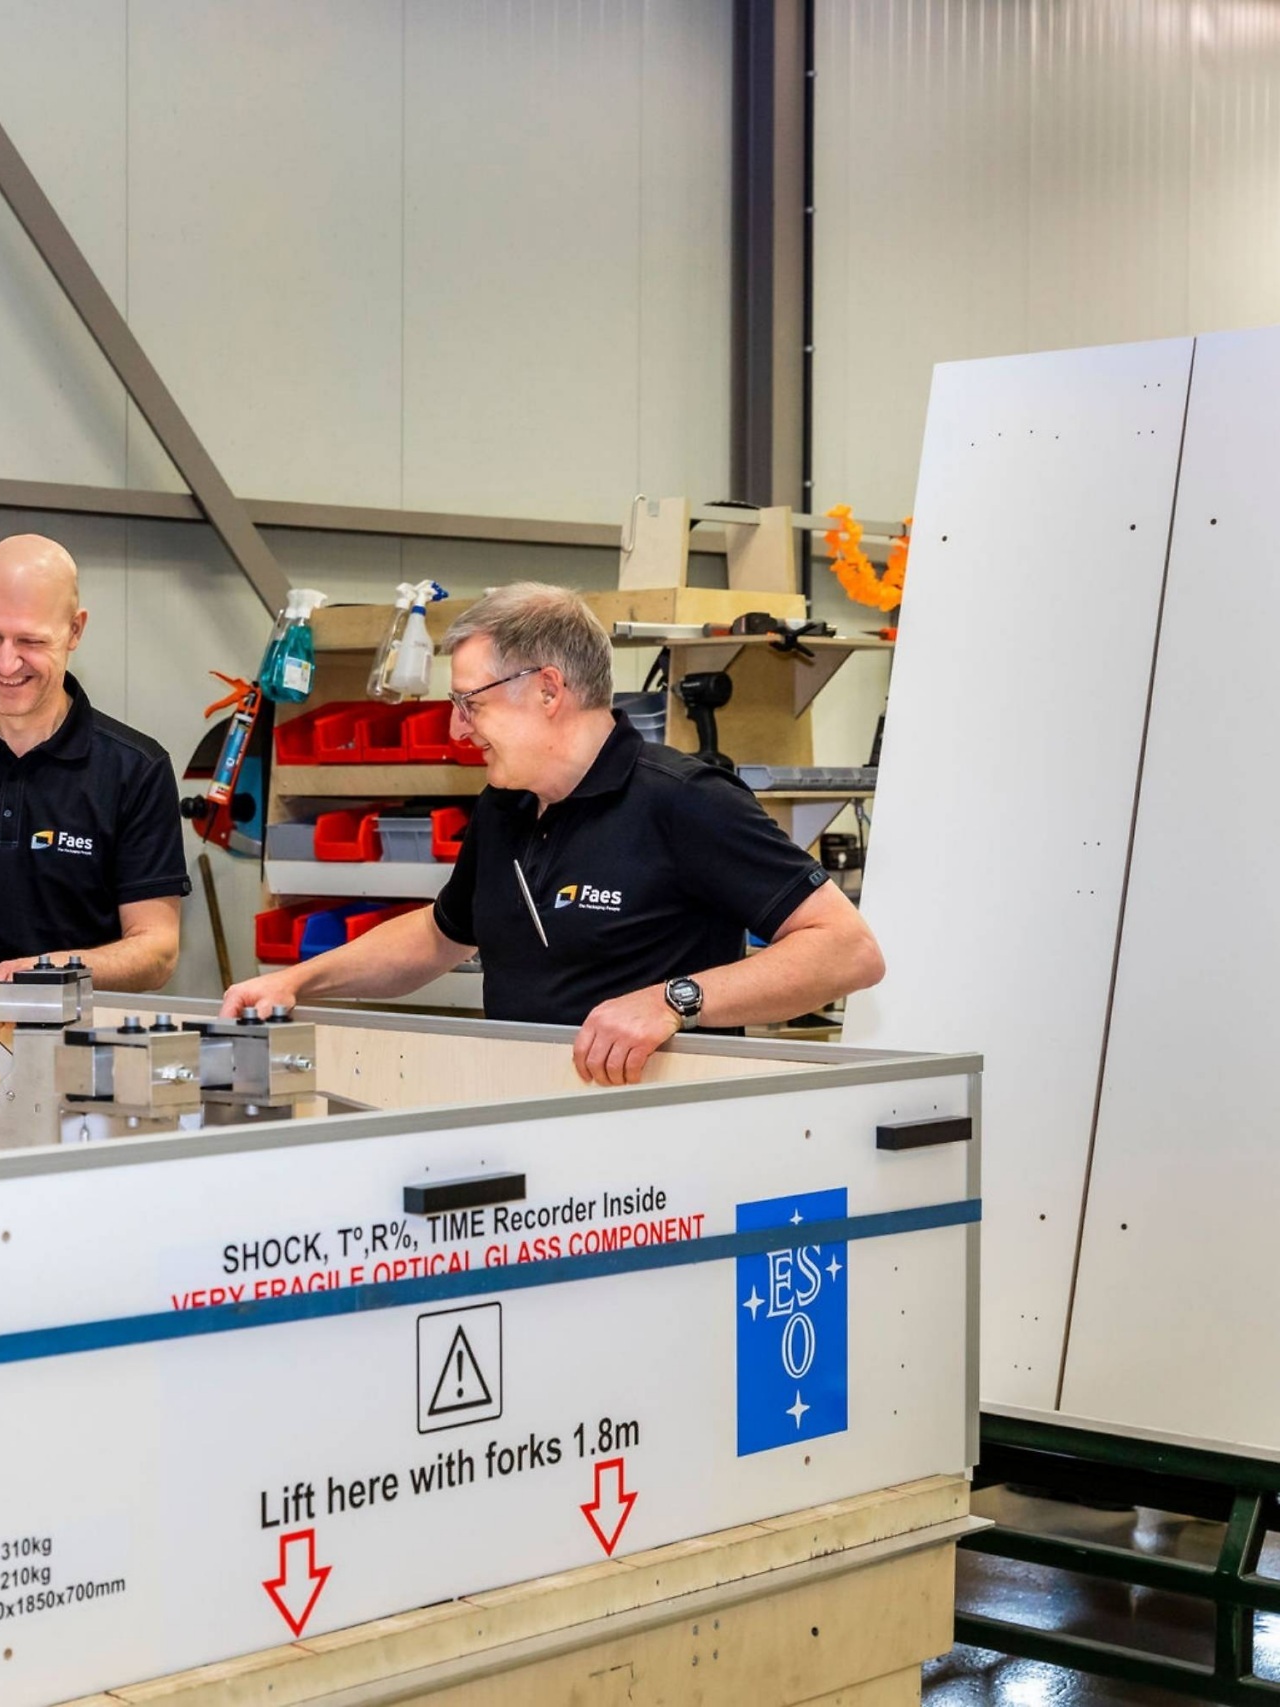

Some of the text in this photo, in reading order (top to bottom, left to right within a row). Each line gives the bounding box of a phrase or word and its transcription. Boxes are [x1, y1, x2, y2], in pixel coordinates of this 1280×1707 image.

[58, 831, 93, 850] Faes
[580, 884, 622, 905] Faes
[222, 1231, 329, 1274] SHOCK,
[426, 1209, 485, 1244] TIME
[493, 1197, 597, 1235] Recorder
[603, 1185, 667, 1219] Inside
[570, 1214, 705, 1257] COMPONENT
[260, 1417, 640, 1529] Lift here with forks 1.8m
[1, 1536, 53, 1561] 310kg
[0, 1566, 52, 1591] 210kg
